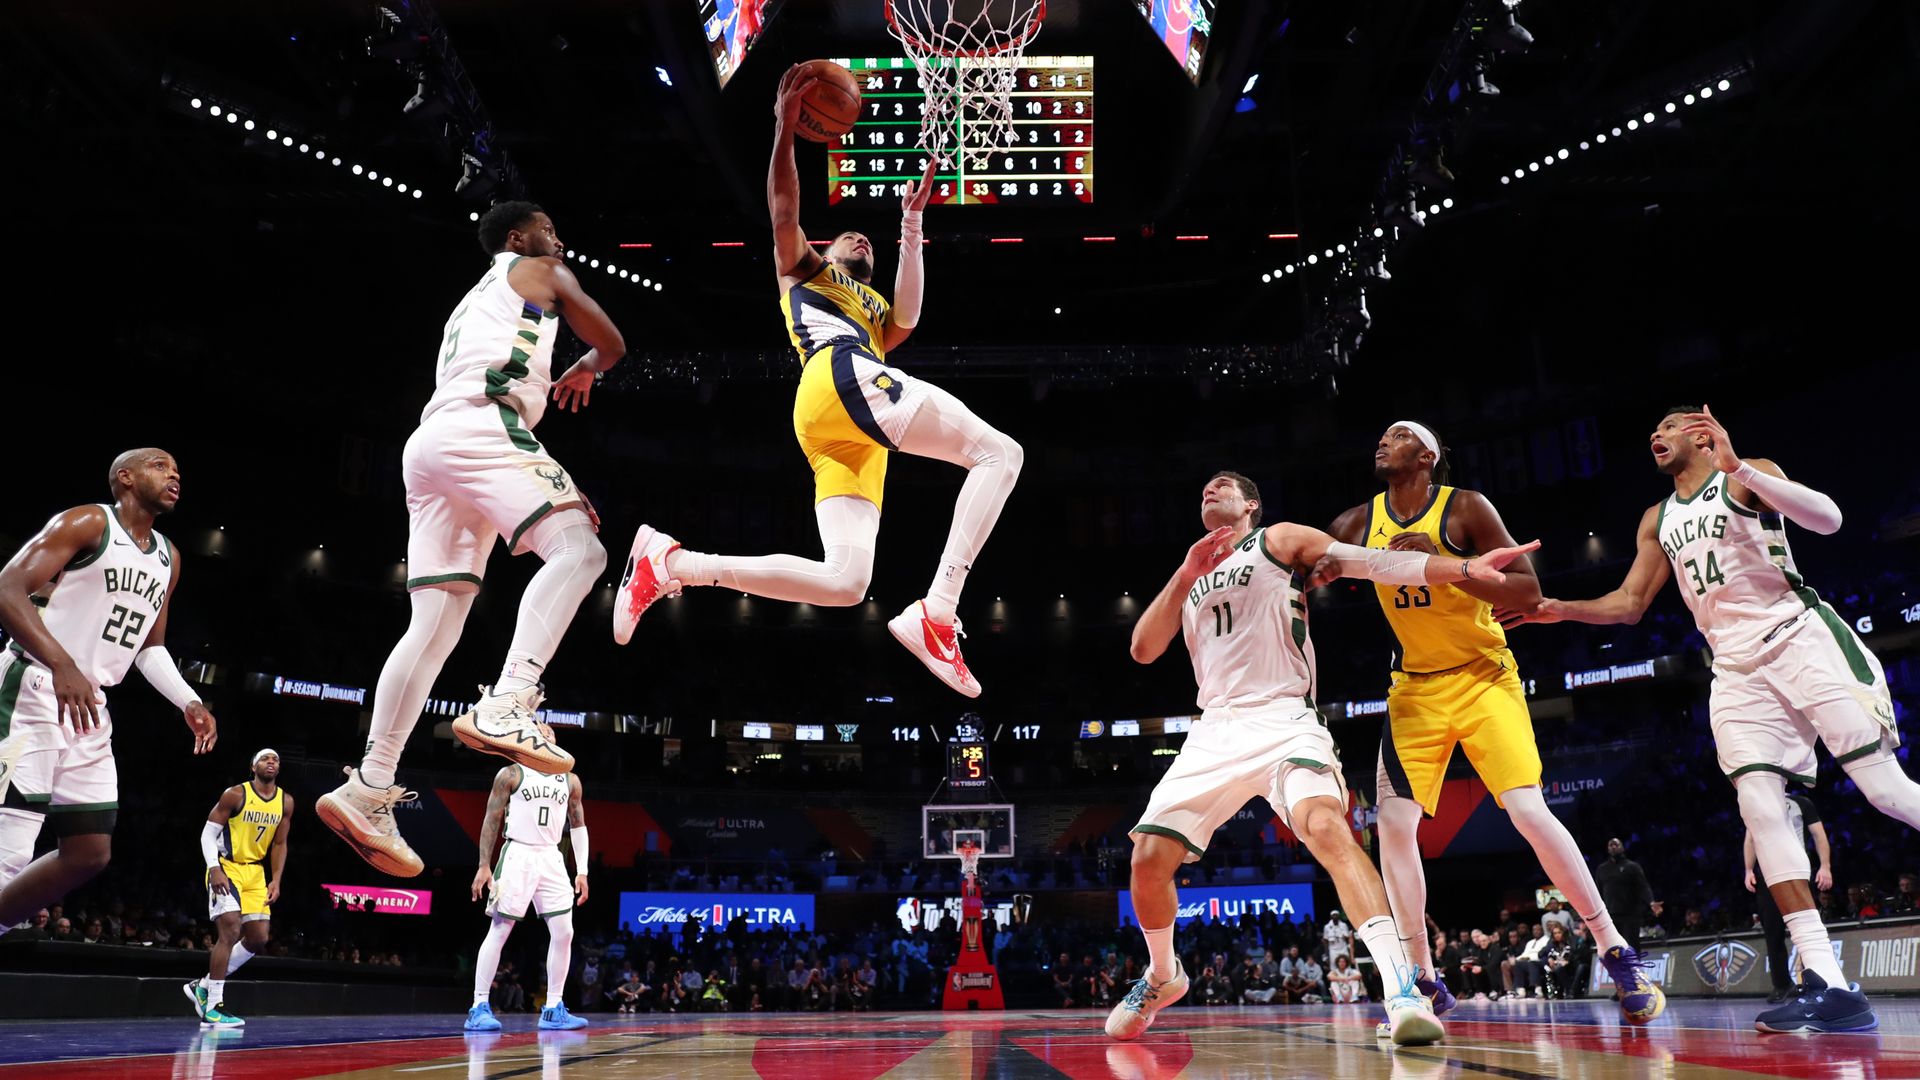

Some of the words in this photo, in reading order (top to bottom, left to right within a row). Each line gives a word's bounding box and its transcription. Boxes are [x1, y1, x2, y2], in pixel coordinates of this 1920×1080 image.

[867, 77, 884, 89] 24
[893, 77, 903, 89] 7
[1029, 75, 1038, 88] 6
[1049, 75, 1066, 88] 15
[1075, 75, 1083, 87] 1
[871, 103, 880, 116] 7
[894, 103, 904, 116] 3
[1026, 102, 1042, 115] 10
[1053, 102, 1062, 114] 2
[1075, 102, 1084, 114] 3
[840, 132, 855, 145] 11
[868, 132, 885, 145] 18
[894, 132, 904, 144] 6
[1029, 130, 1038, 143] 3
[1053, 130, 1060, 143] 1
[1075, 130, 1084, 143] 2
[840, 159, 856, 172] 22
[869, 159, 885, 171] 15
[895, 159, 904, 171] 7
[1005, 157, 1014, 170] 6
[1030, 157, 1037, 170] 1
[1053, 157, 1060, 170] 1
[1075, 157, 1084, 170] 5
[840, 185, 857, 197] 34
[869, 184, 885, 197] 37
[893, 184, 907, 197] 10
[940, 184, 949, 196] 2
[972, 183, 989, 196] 33
[1001, 183, 1018, 196] 26
[1029, 183, 1038, 196] 8
[1053, 183, 1062, 195] 2
[1075, 182, 1084, 195] 2
[444, 304, 470, 369] 5
[1663, 514, 1728, 561] BUCKS
[1684, 550, 1725, 596] 34
[103, 567, 166, 612] BUCKS
[1189, 565, 1254, 607] BUCKS
[1394, 584, 1432, 609] 33
[1212, 601, 1233, 637] 11
[1856, 615, 1873, 633] G
[101, 604, 146, 650] 22
[1574, 669, 1610, 688] IN-SEASON
[1609, 659, 1655, 683] TOURNAMENT
[283, 680, 322, 697] IN-SEASON
[321, 683, 366, 705] TOURNAMENT
[1354, 700, 1387, 715] IN-SEASON
[755, 729, 761, 738] 2
[892, 727, 920, 741] 114
[1013, 725, 1041, 740] 117
[1123, 726, 1129, 736] 2
[1176, 722, 1182, 732] 5
[807, 731, 813, 740] 2
[969, 759, 980, 778] 5
[1561, 778, 1605, 793] ULTRA
[521, 785, 568, 805] BUCKS
[538, 806, 549, 826] 0
[727, 818, 765, 830] ULTRA
[255, 825, 267, 842] 7
[375, 897, 411, 907] ARENA
[1223, 898, 1296, 917] ULTRA
[1860, 937, 1920, 977] TONIGHT
